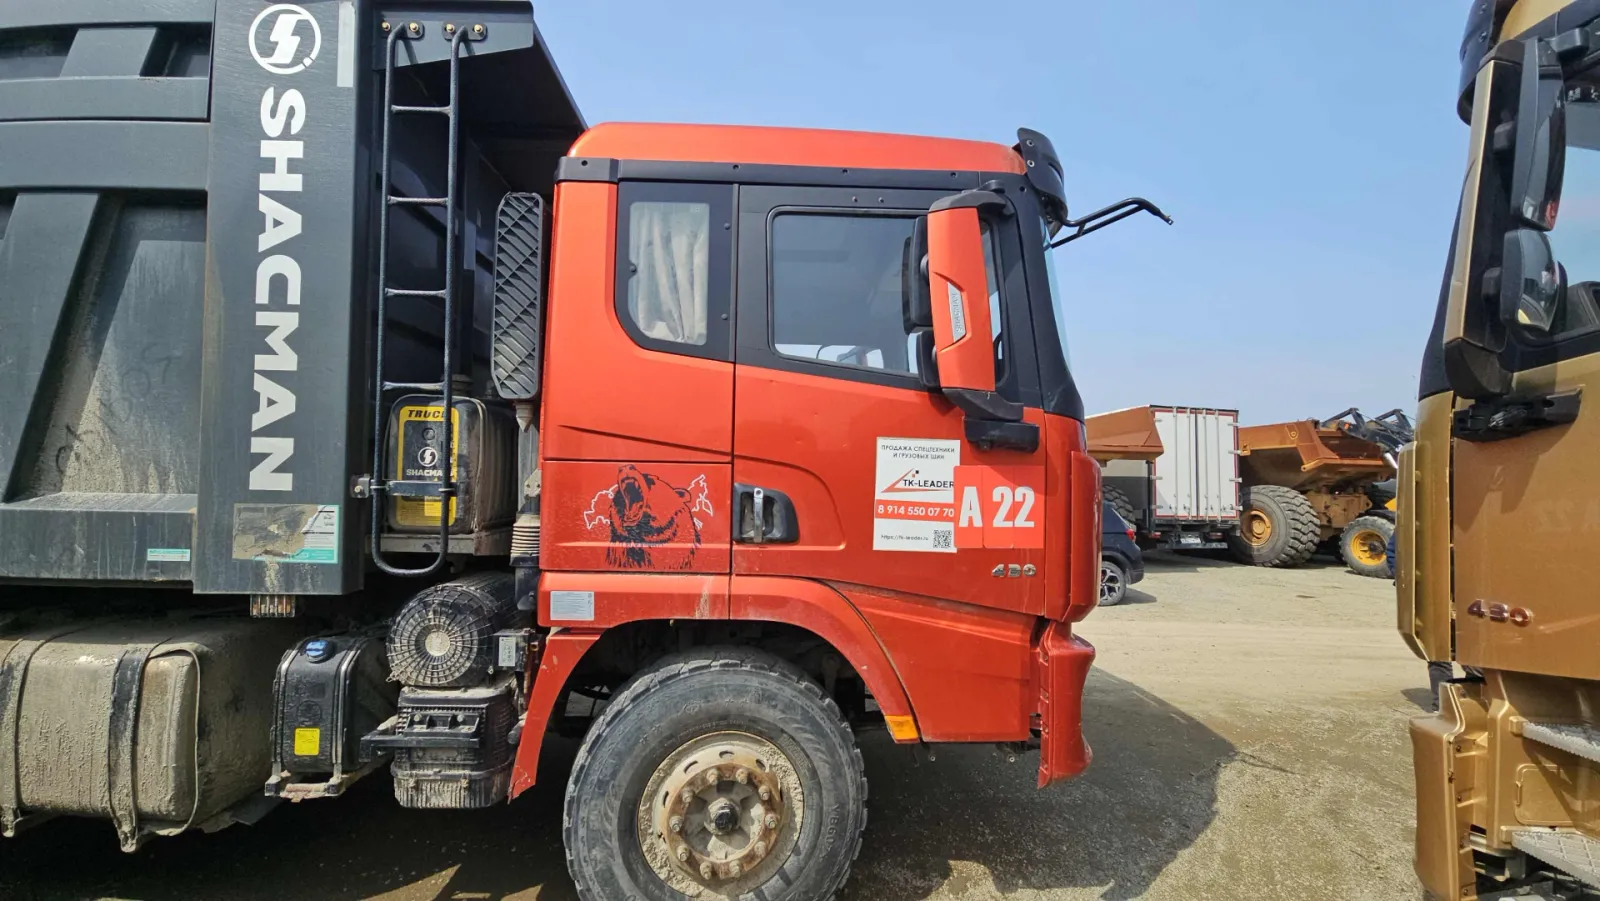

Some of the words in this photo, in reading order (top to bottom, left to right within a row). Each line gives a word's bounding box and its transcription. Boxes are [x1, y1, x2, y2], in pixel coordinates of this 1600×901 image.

[248, 86, 307, 491] SHACMAN
[406, 469, 443, 477] SHACMA
[902, 479, 954, 488] TK-LEADER
[877, 504, 885, 514] 8
[887, 505, 905, 515] 914
[907, 506, 926, 516] 550
[927, 507, 941, 517] 07
[942, 508, 955, 518] 70
[958, 486, 983, 528] A
[992, 486, 1035, 528] 22
